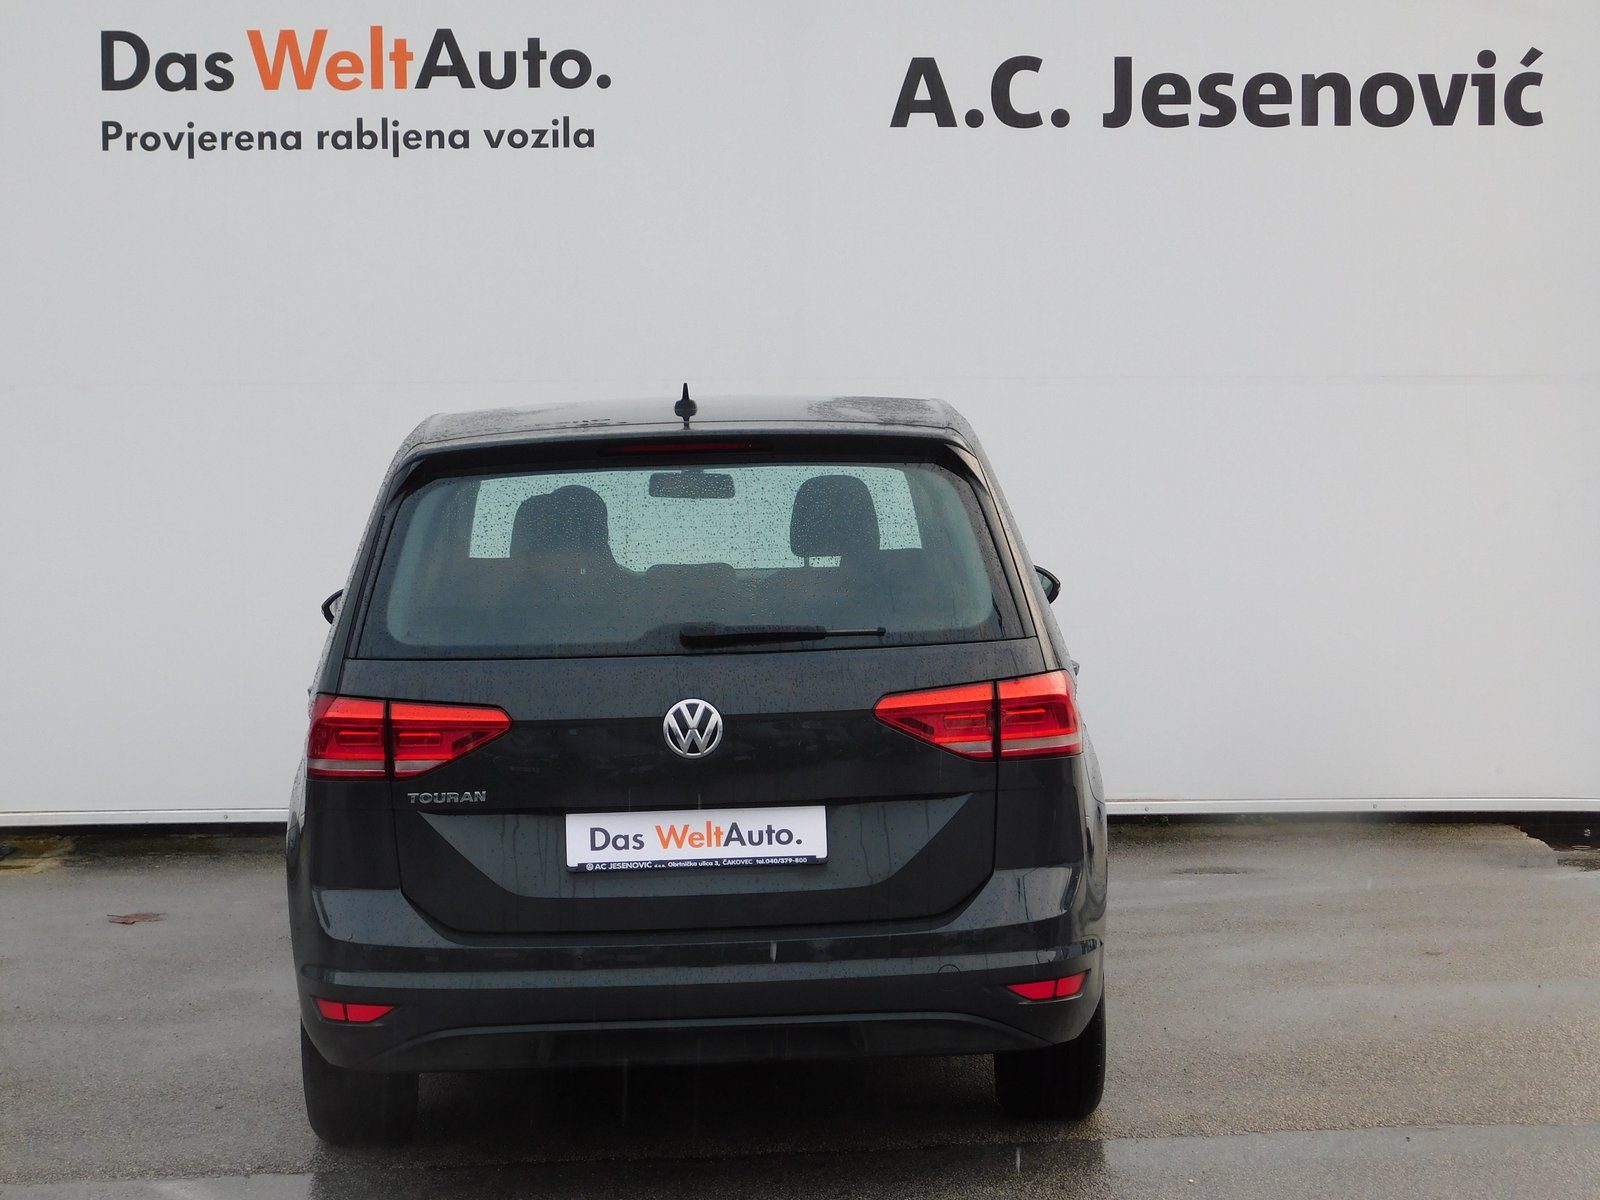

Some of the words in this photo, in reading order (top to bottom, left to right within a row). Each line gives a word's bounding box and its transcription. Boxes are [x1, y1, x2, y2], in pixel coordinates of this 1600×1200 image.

[101, 30, 234, 92] Das
[247, 26, 612, 91] WeltAuto.
[890, 55, 1071, 128] A.C.
[1102, 46, 1544, 128] Jesenović
[101, 121, 302, 159] Provjerena
[317, 117, 470, 158] rabljena
[484, 116, 595, 149] vozila
[407, 791, 487, 804] TOURAN
[589, 827, 645, 851] Das
[655, 821, 803, 849] WeltAuto.
